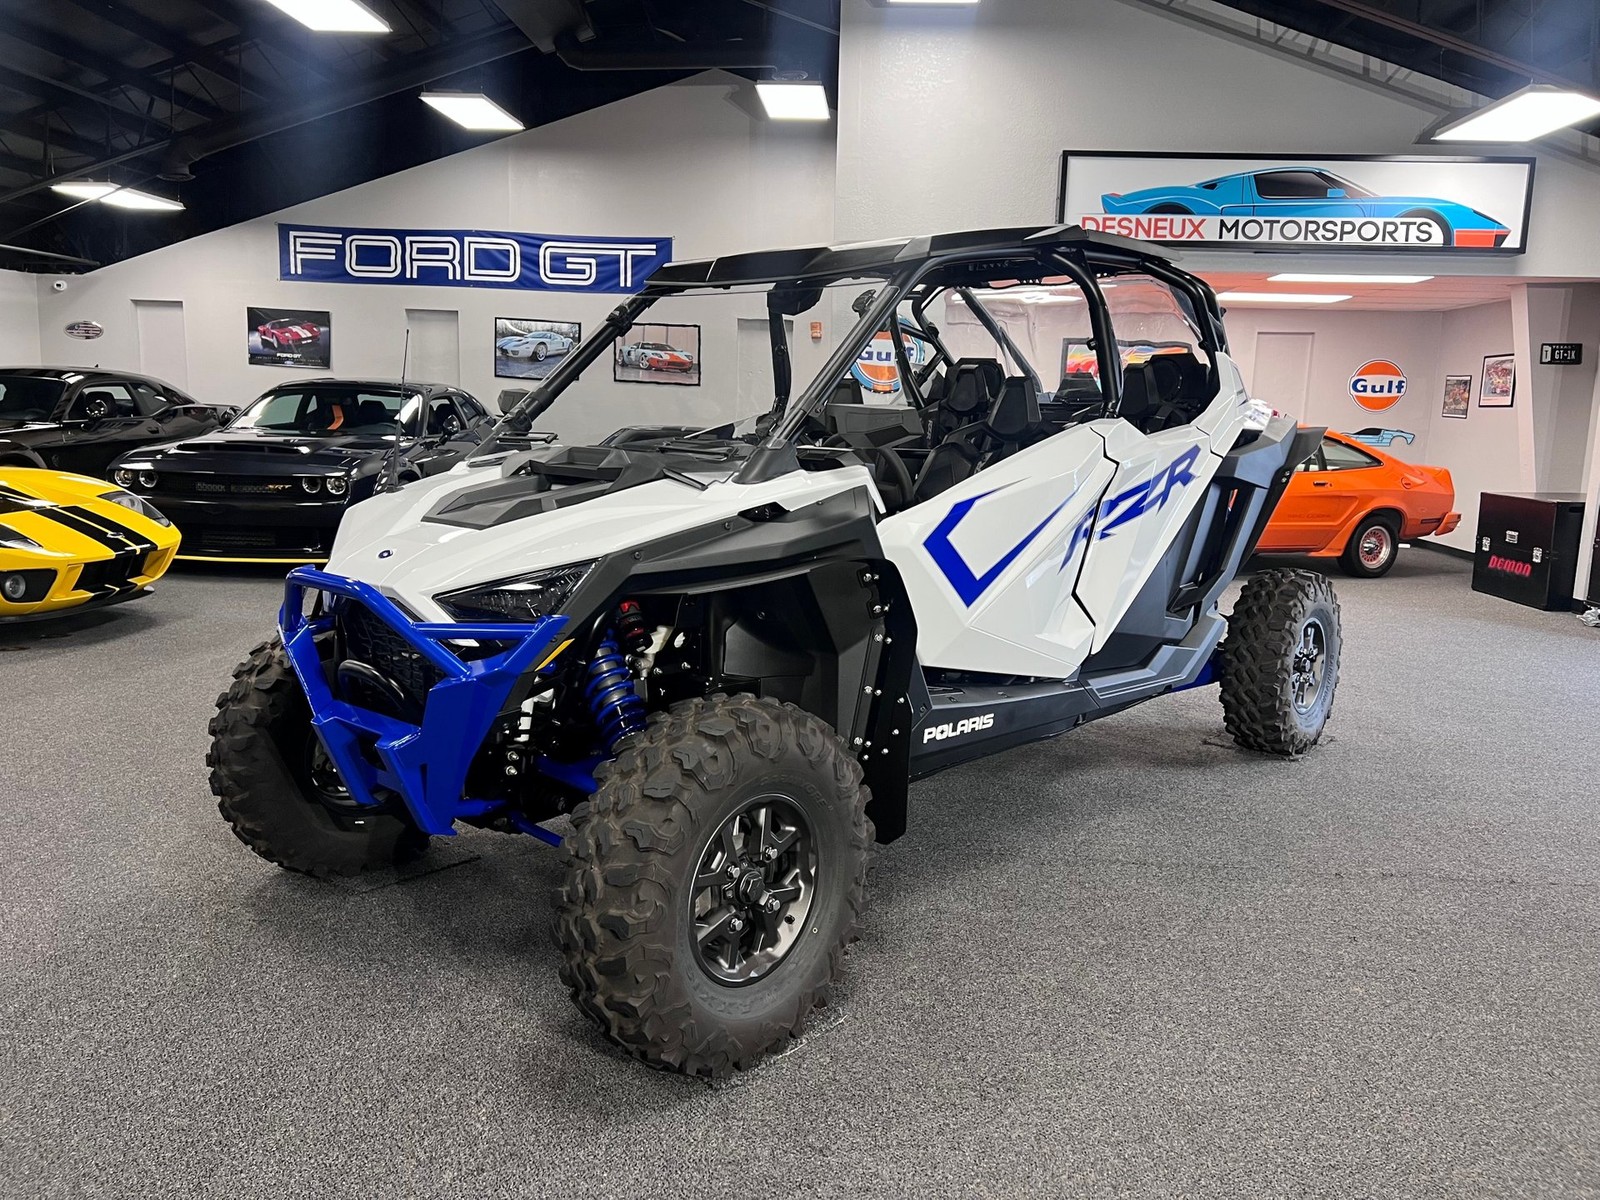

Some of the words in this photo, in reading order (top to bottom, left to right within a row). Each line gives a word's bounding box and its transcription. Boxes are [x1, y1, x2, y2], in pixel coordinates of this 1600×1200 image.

[1081, 216, 1206, 240] DESNEUX
[1218, 218, 1433, 243] MOTORSPORTS
[289, 230, 520, 282] FORD
[539, 242, 656, 288] GT
[859, 344, 914, 362] Guf
[1351, 378, 1405, 394] Gulf
[922, 713, 994, 744] POLARIS
